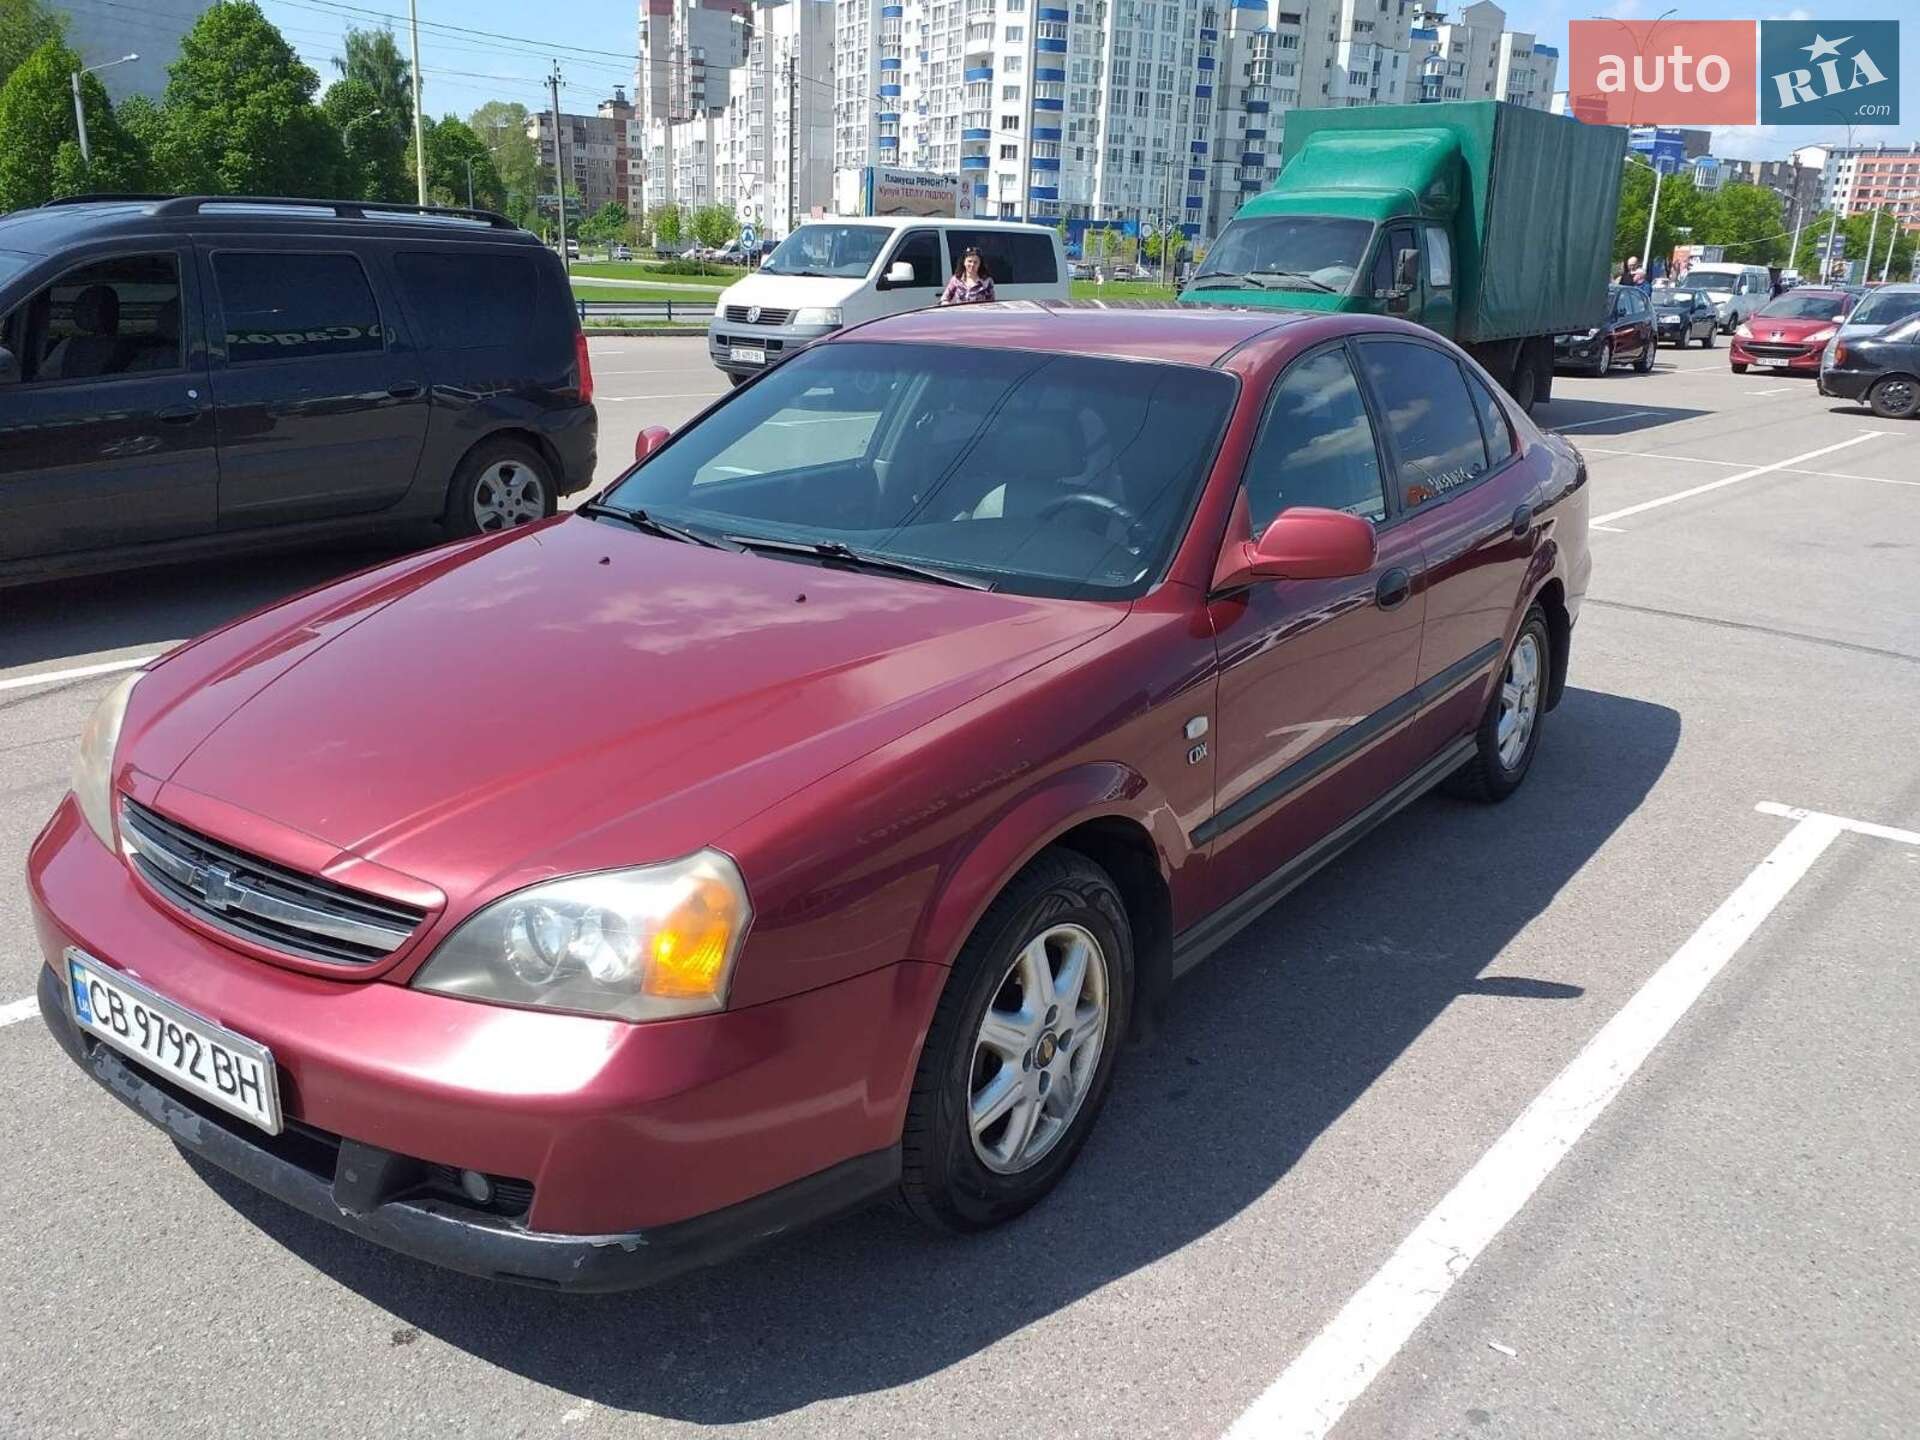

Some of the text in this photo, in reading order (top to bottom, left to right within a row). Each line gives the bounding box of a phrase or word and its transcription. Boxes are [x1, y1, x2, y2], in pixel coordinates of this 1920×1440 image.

[916, 177, 949, 188] РЕМОНТ?
[1188, 741, 1207, 764] CDX
[90, 980, 264, 1112] CB 9792 BH
